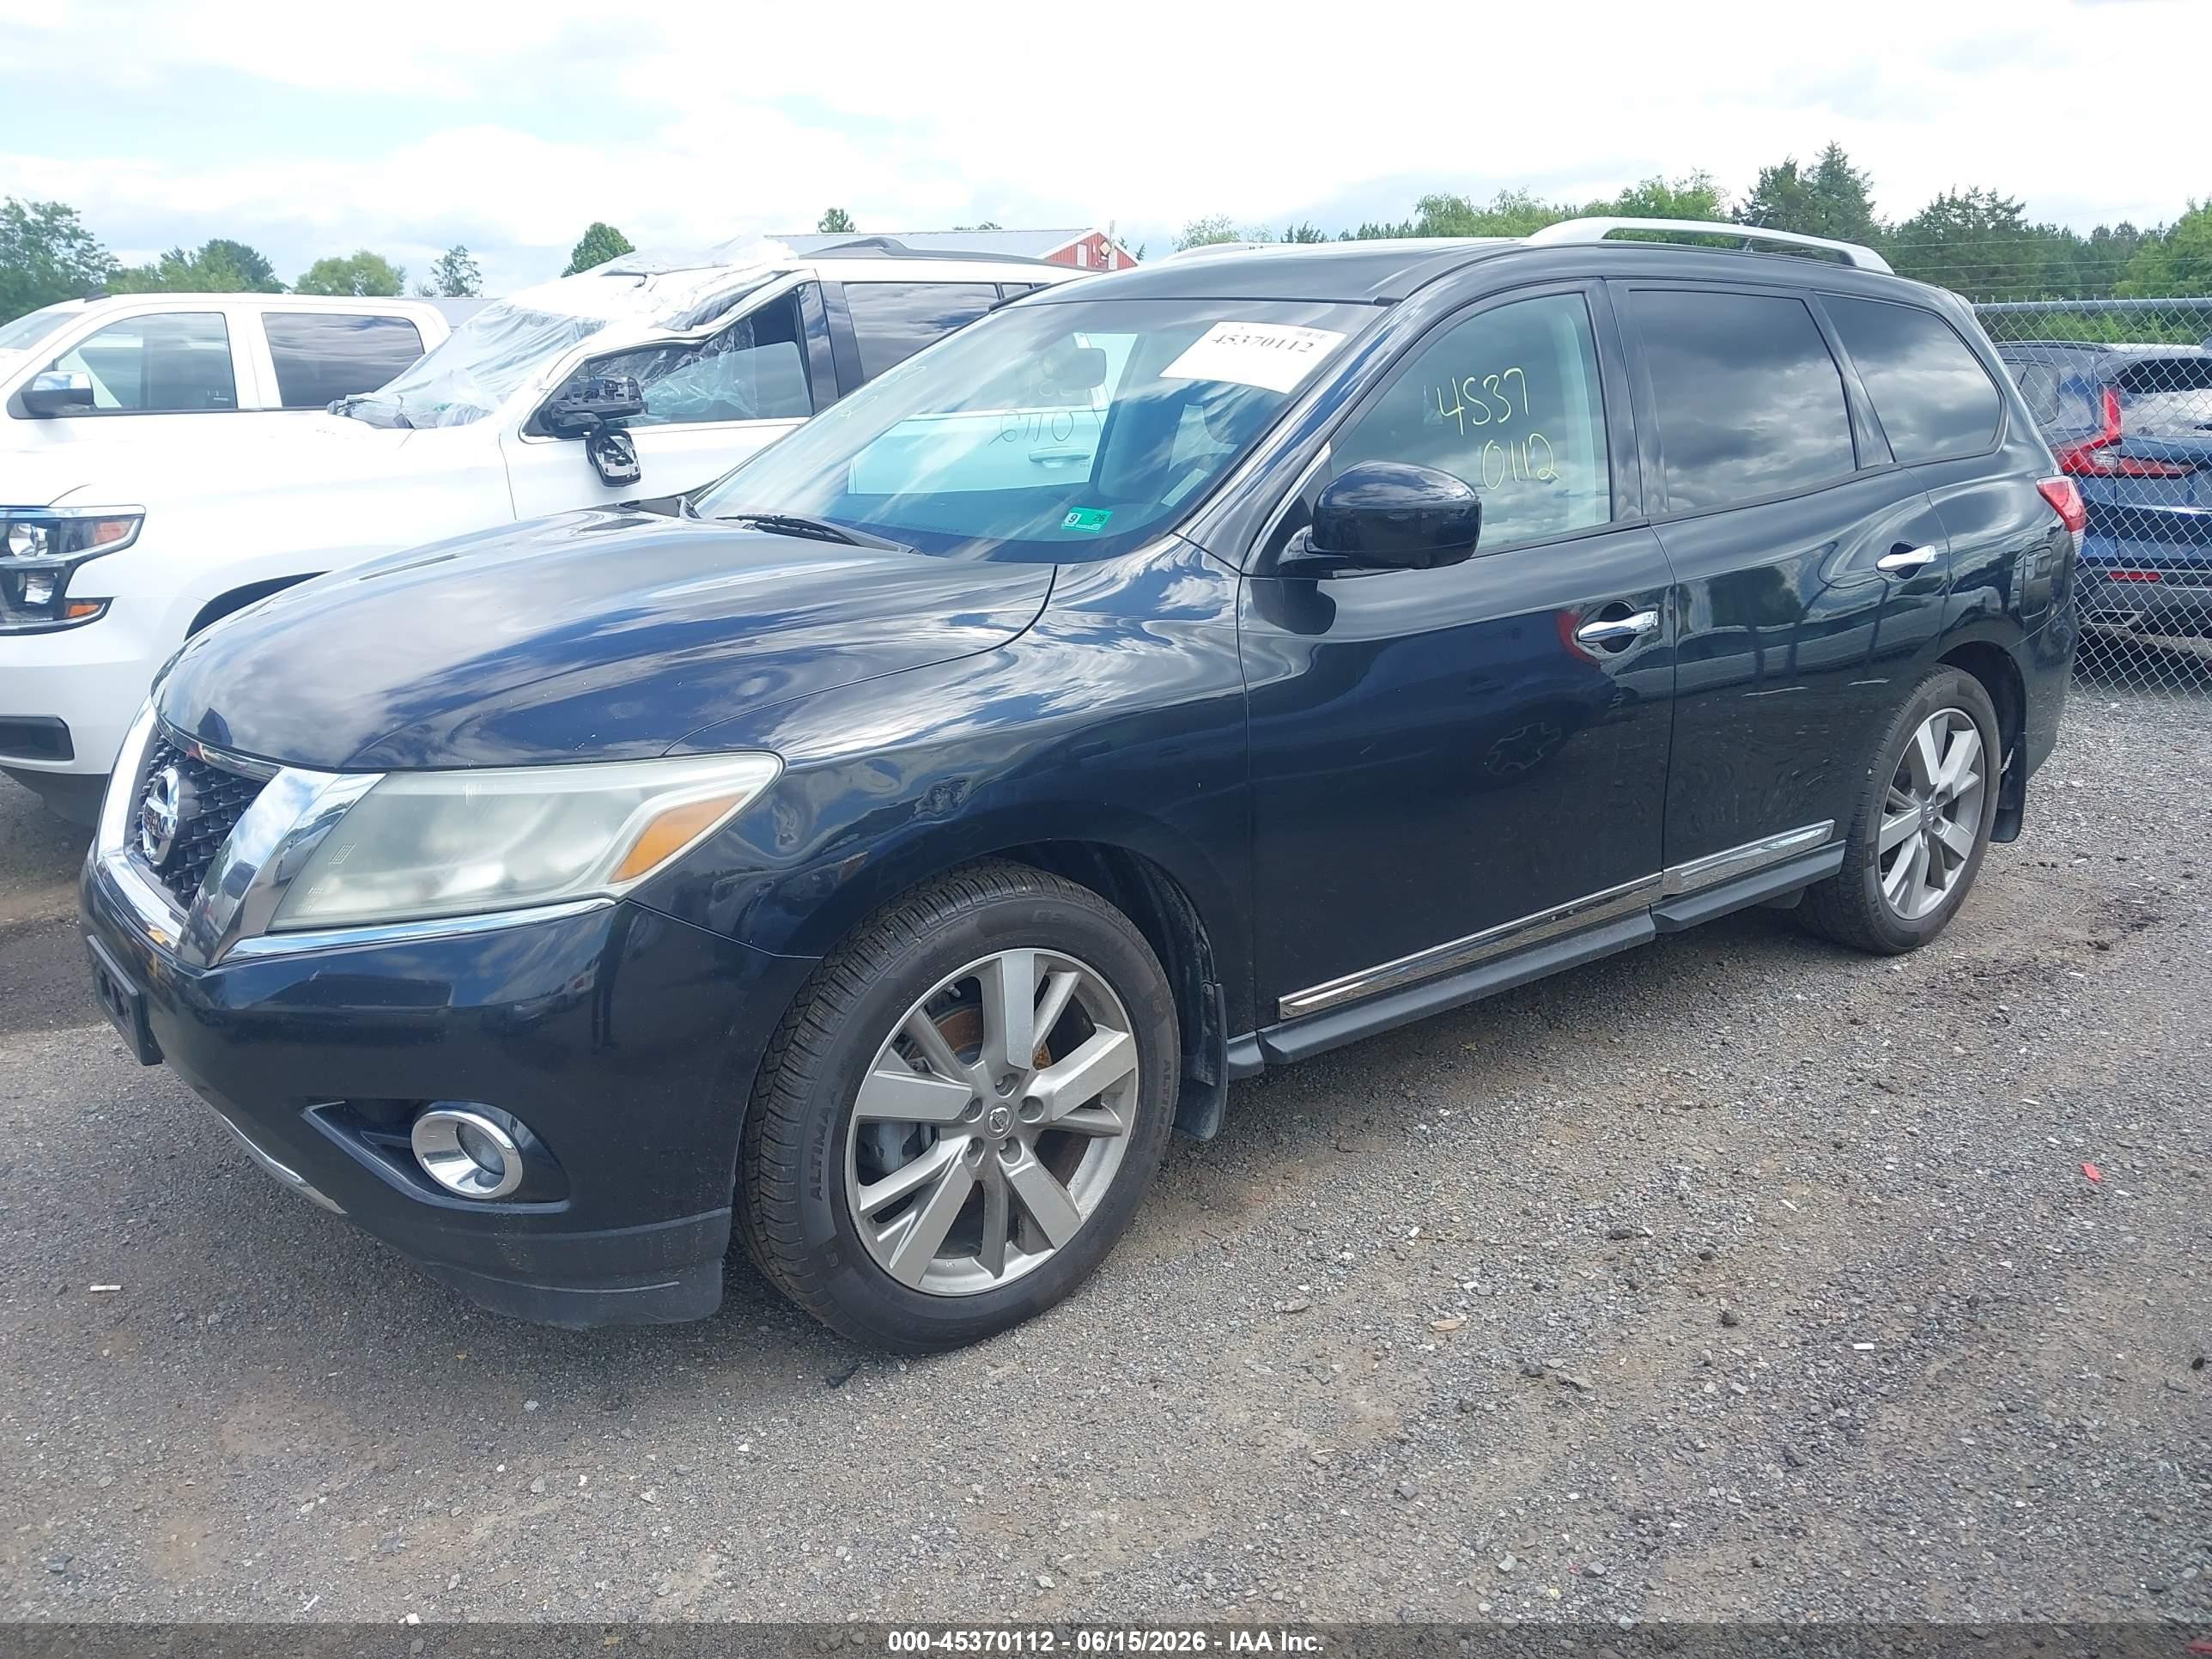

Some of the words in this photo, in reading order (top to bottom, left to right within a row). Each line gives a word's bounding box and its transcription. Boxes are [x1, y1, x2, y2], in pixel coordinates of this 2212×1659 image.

[1212, 333, 1315, 353] 45370112
[1436, 366, 1529, 435] 4537
[1481, 432, 1561, 489] 0112
[1068, 514, 1079, 523] 9
